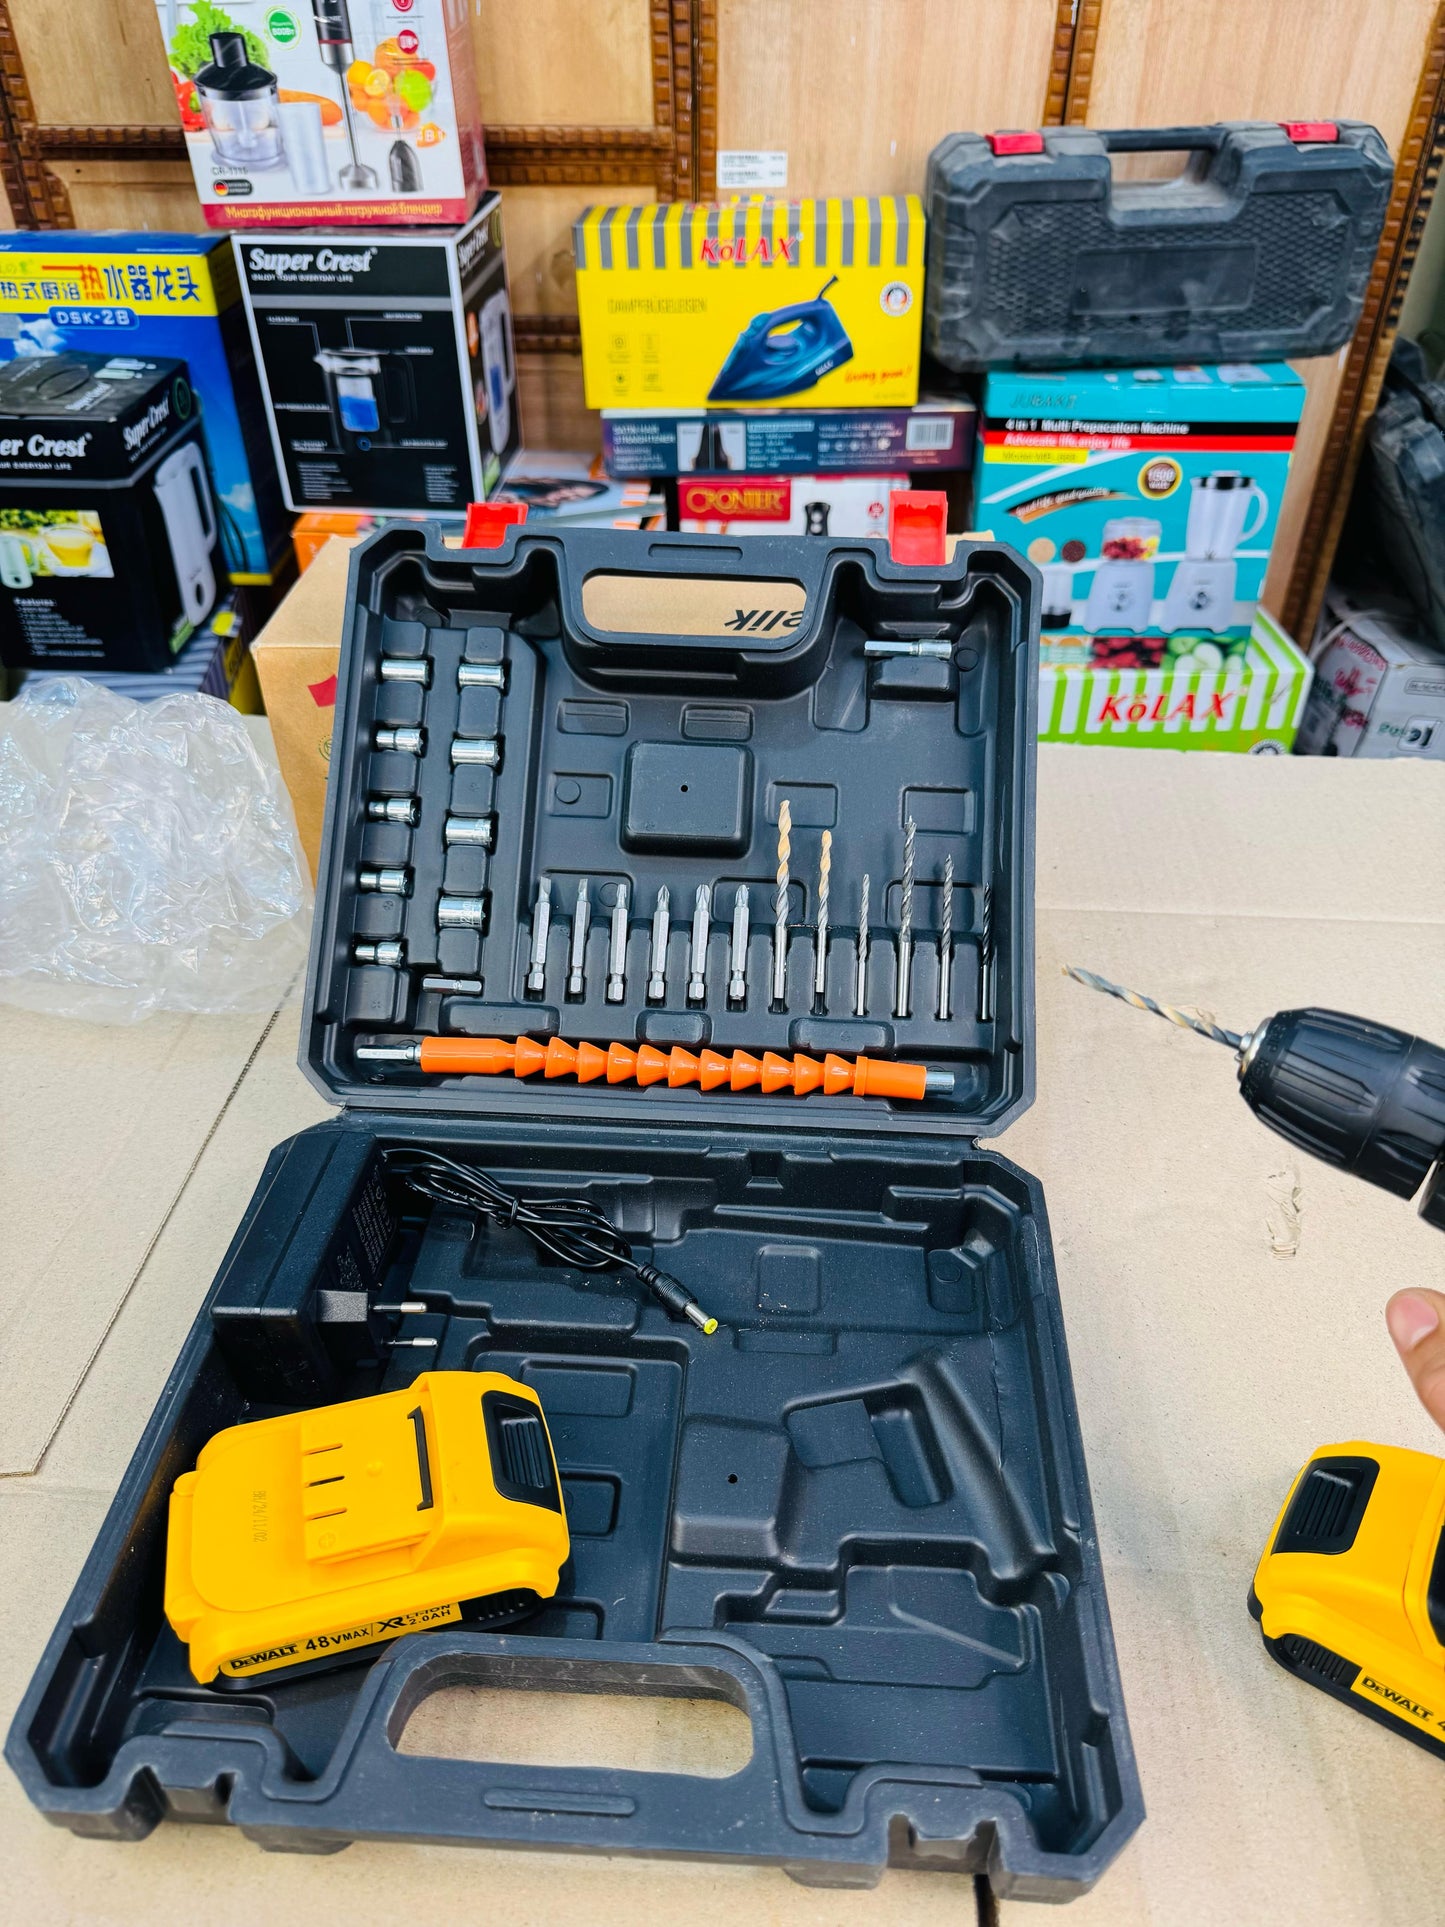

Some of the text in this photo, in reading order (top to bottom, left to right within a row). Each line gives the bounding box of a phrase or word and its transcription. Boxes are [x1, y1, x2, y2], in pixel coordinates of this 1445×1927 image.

[250, 248, 372, 276] Super Crest
[27, 433, 87, 457] Crest
[123, 416, 149, 450] Super
[408, 1609, 452, 1626] 2.0AH
[230, 1643, 299, 1670] DeWALT
[378, 1615, 404, 1633] XR
[1361, 1675, 1434, 1721] DeWALT
